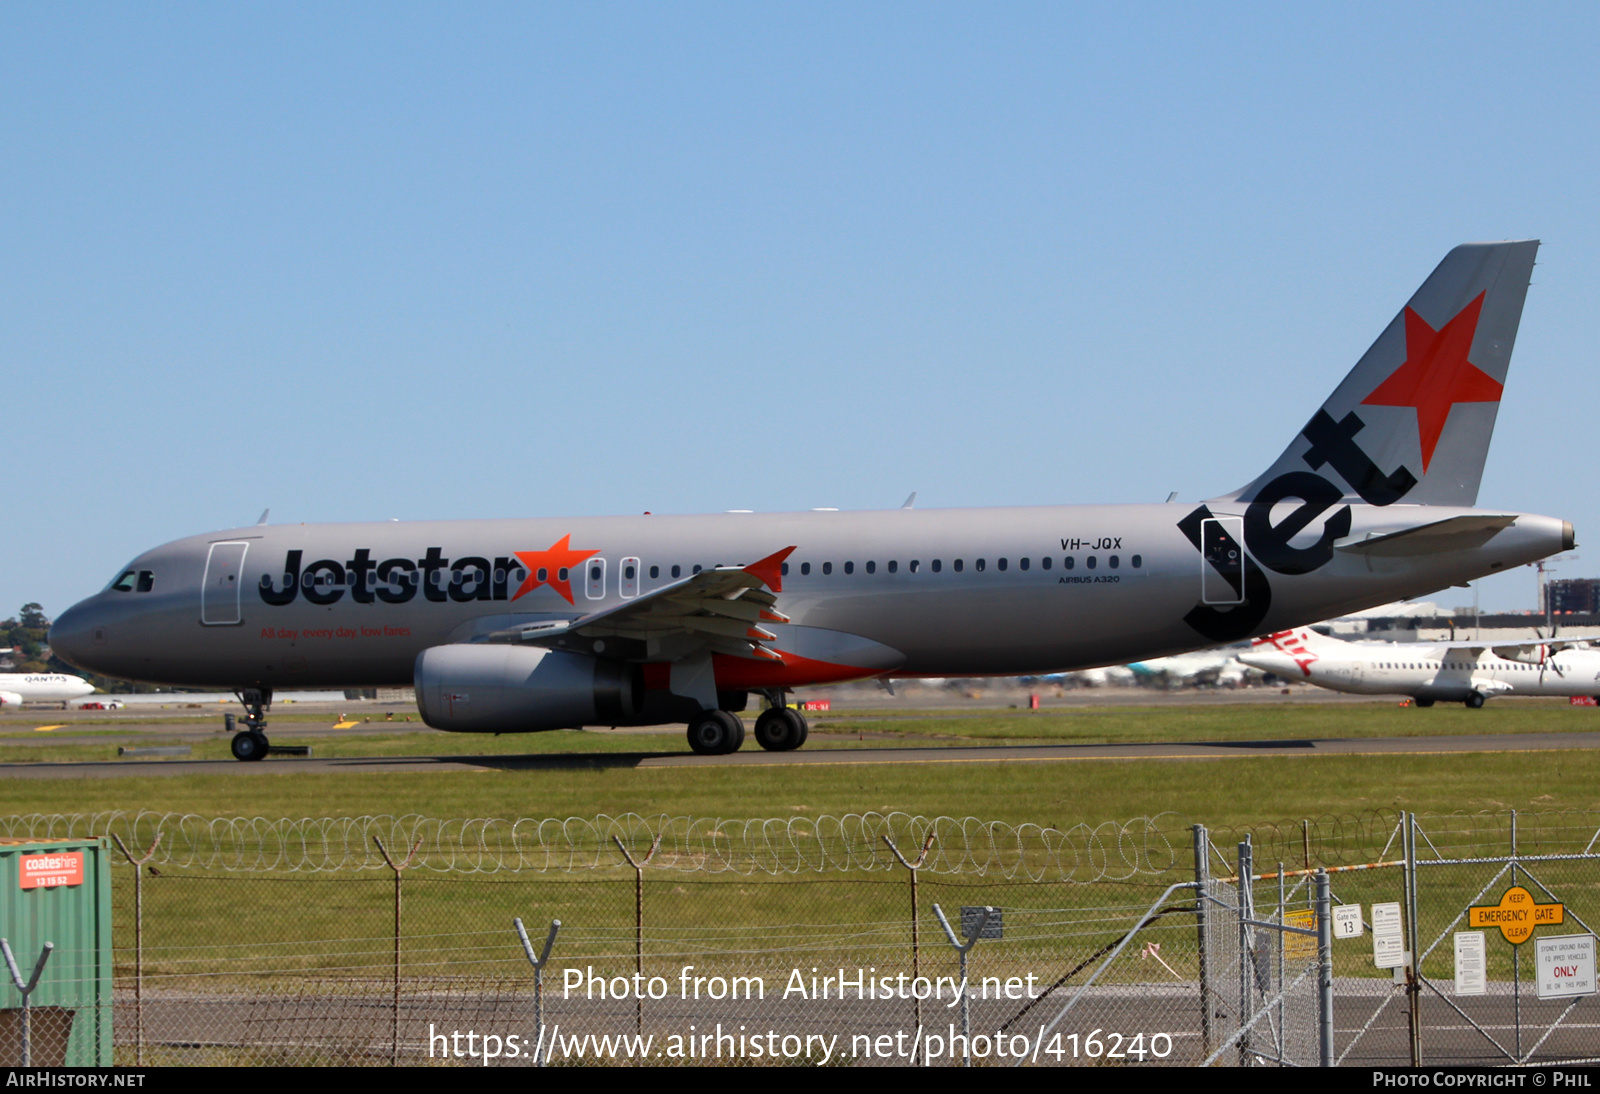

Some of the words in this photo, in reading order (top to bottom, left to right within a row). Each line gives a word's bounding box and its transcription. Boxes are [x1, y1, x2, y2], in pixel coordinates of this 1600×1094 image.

[1177, 408, 1418, 642] Jet
[1061, 536, 1122, 551] VH-JQX
[259, 547, 523, 606] Jetstar
[1058, 576, 1092, 584] AIRBUS
[1094, 575, 1120, 584] A320
[260, 628, 275, 639] All
[302, 629, 333, 640] every
[361, 626, 381, 637] low
[383, 625, 412, 637] fares
[24, 675, 67, 683] QANTAS
[36, 877, 46, 886] 13
[47, 877, 57, 885] 15
[57, 876, 68, 885] 52
[1508, 894, 1526, 903] KEEP
[1336, 913, 1349, 921] Gate
[1479, 909, 1529, 923] EMERGENCY
[1534, 908, 1554, 921] GATE
[1343, 921, 1354, 933] 13
[1507, 927, 1528, 937] CLEAR
[1540, 945, 1557, 953] SYDNEY
[1558, 943, 1576, 951] GROUND
[1553, 965, 1578, 978] ONLY
